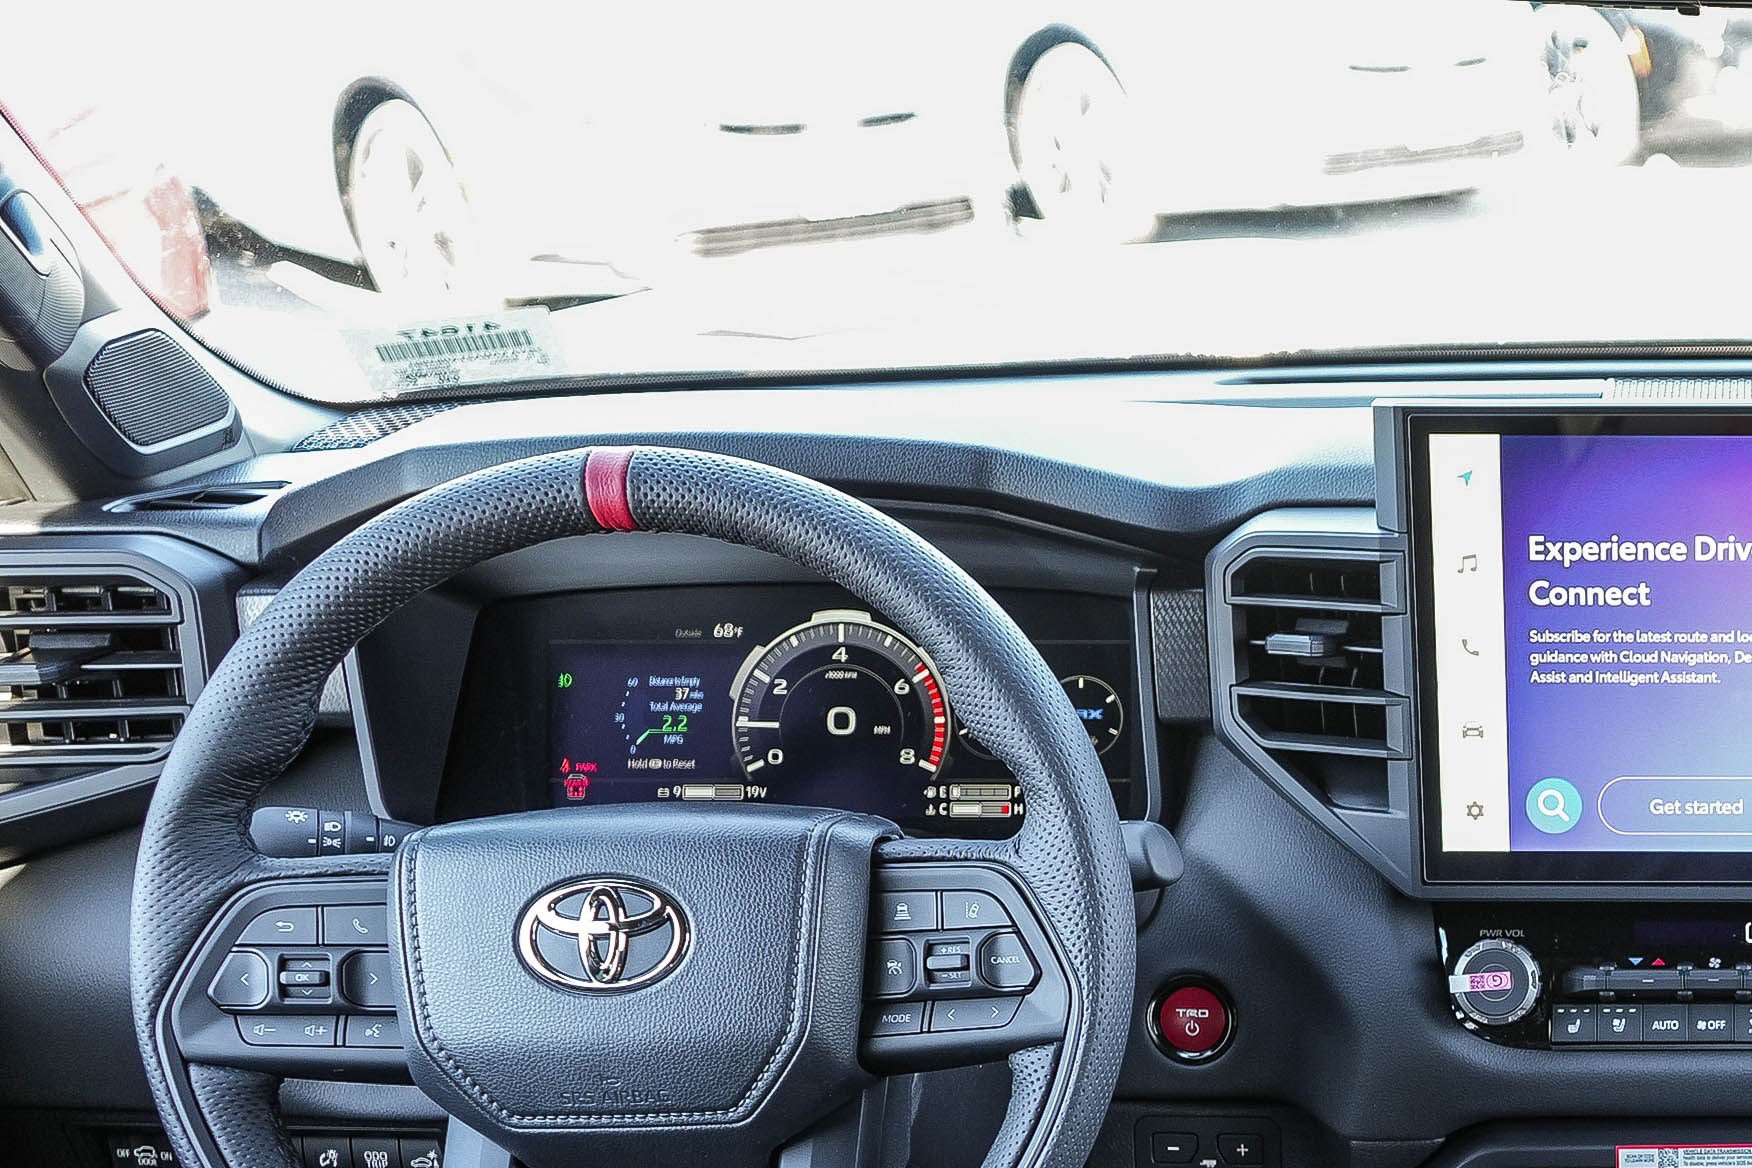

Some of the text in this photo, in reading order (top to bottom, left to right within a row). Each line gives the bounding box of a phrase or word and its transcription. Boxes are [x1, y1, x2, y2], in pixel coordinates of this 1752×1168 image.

[1528, 534, 1688, 568] Experience
[1528, 580, 1652, 607] Connect
[1529, 629, 1591, 643] Subscribe
[1593, 629, 1611, 643] for
[1612, 629, 1635, 643] the
[1635, 629, 1672, 643] latest
[1674, 631, 1708, 644] route
[1710, 630, 1735, 644] and
[832, 647, 848, 662] 4
[1529, 650, 1589, 666] guidance
[1590, 650, 1618, 664] with
[1619, 650, 1658, 664] Cloud
[1660, 651, 1732, 666] Navigation,
[1530, 670, 1721, 687] Assist and Intelligent Assistant.
[773, 679, 788, 695] 2
[894, 678, 910, 695] 6
[650, 702, 703, 714] Total Average
[662, 715, 688, 732] 2.2
[827, 706, 857, 735] 0
[628, 758, 648, 769] Hold
[672, 759, 696, 769] Reset
[767, 749, 783, 765] 0
[900, 749, 915, 765] 8
[939, 804, 948, 815] C
[1649, 798, 1745, 815] Get started
[1480, 929, 1526, 937] PWR VOL
[991, 956, 1020, 964] CANCEL
[295, 974, 309, 982] OK
[882, 1014, 912, 1023] MODE
[1176, 1008, 1209, 1018] TRD
[1651, 1020, 1679, 1030] AUTO
[1708, 1020, 1726, 1030] OFF
[116, 1149, 129, 1158] OFF
